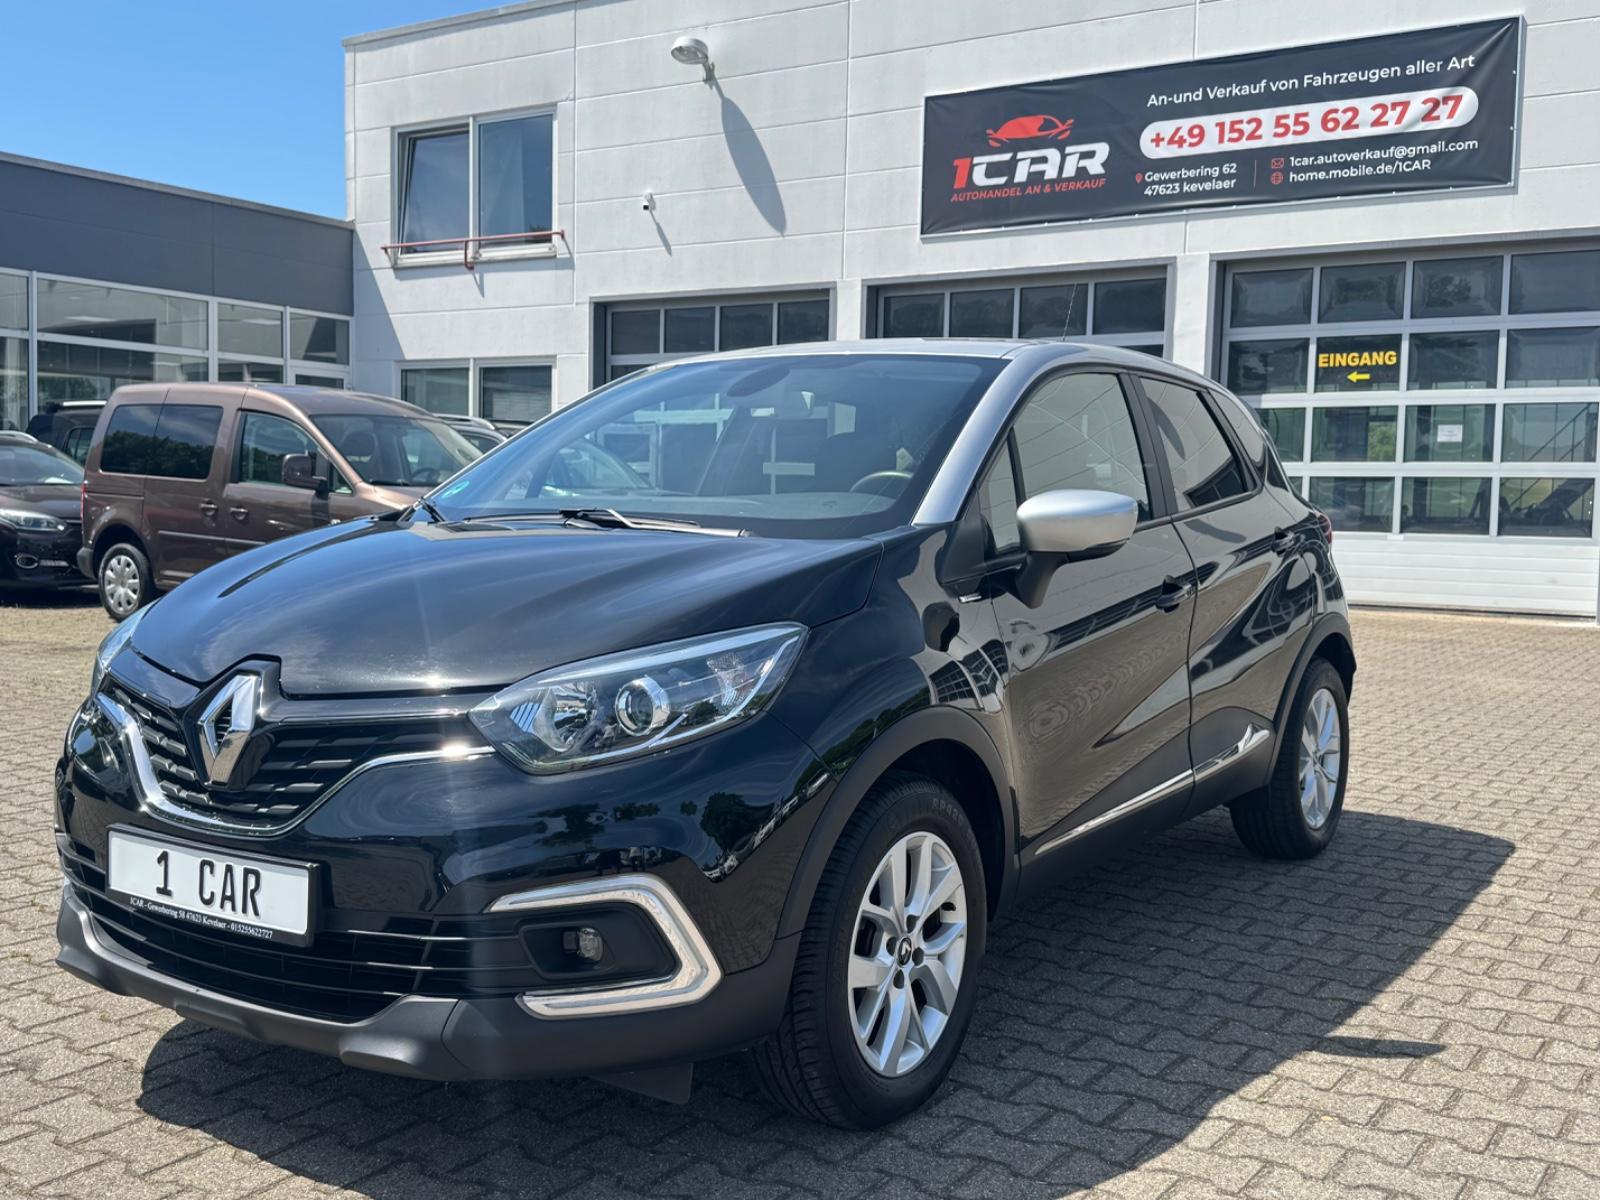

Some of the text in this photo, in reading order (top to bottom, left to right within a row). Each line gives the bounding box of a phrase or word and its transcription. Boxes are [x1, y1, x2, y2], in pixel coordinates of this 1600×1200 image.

[1147, 55, 1475, 107] An-und Verkauf von Fahrzeugen aller Art
[1150, 95, 1463, 149] +49 152 55 62 27 27
[953, 142, 1110, 189] 1CAR
[1289, 140, 1479, 166] 1car.autoverkauf@gmail.com
[1144, 163, 1238, 182] Gewerbering 62
[1289, 159, 1431, 182] home.mobile.de/1CAR
[951, 178, 1107, 203] AUTOHANDEL AN & VERKAUF
[1144, 178, 1237, 196] 47623 kevelaer
[1318, 351, 1397, 368] EINGANG
[156, 850, 261, 917] 1 CAR
[178, 910, 185, 920] 58
